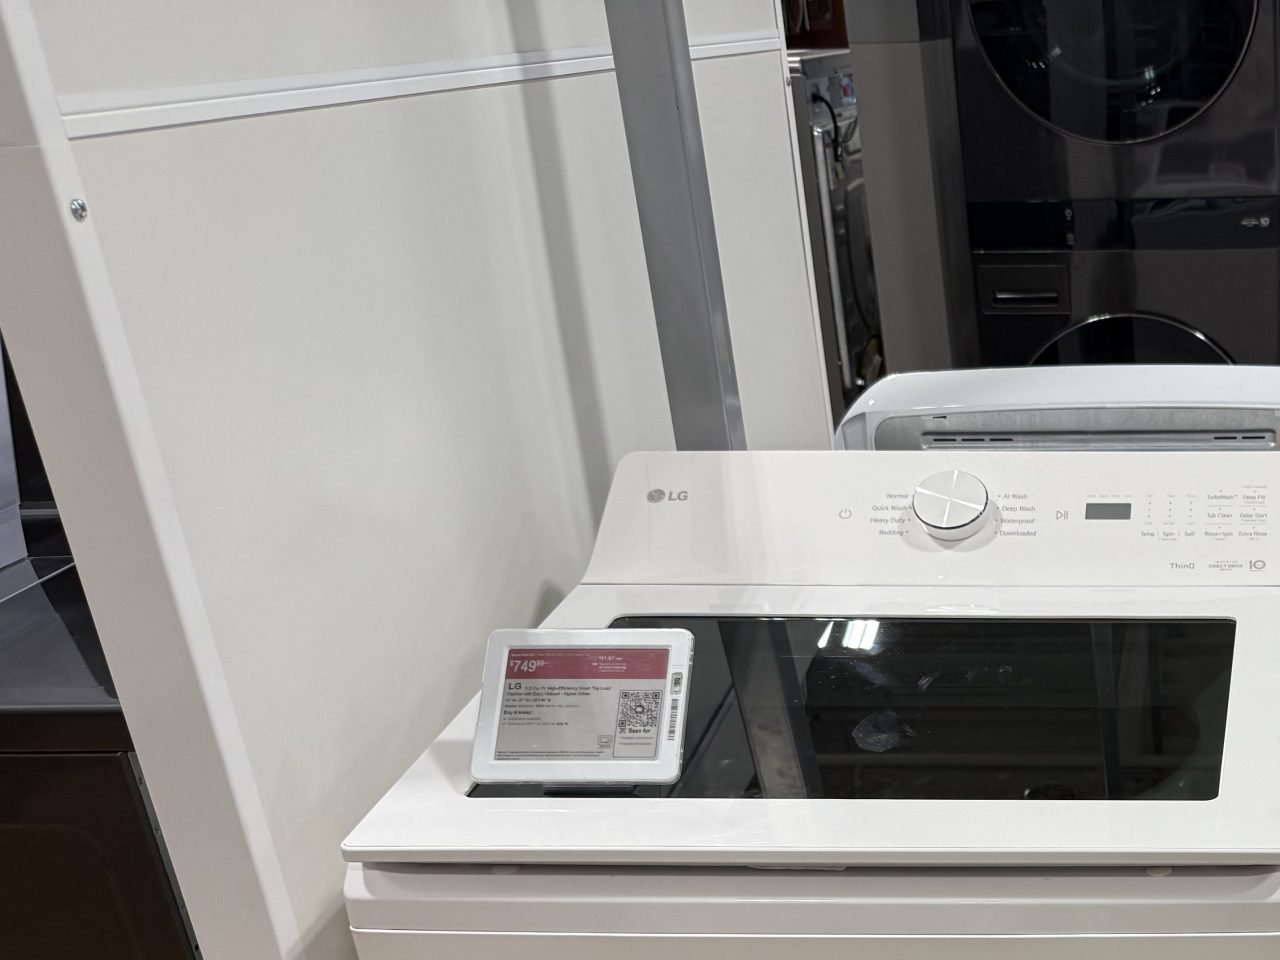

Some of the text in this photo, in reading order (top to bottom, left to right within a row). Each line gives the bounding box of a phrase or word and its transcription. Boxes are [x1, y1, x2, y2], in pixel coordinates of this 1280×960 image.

[668, 490, 689, 501] LG
[1169, 562, 1195, 570] ThinQ
[508, 682, 523, 690] LG
